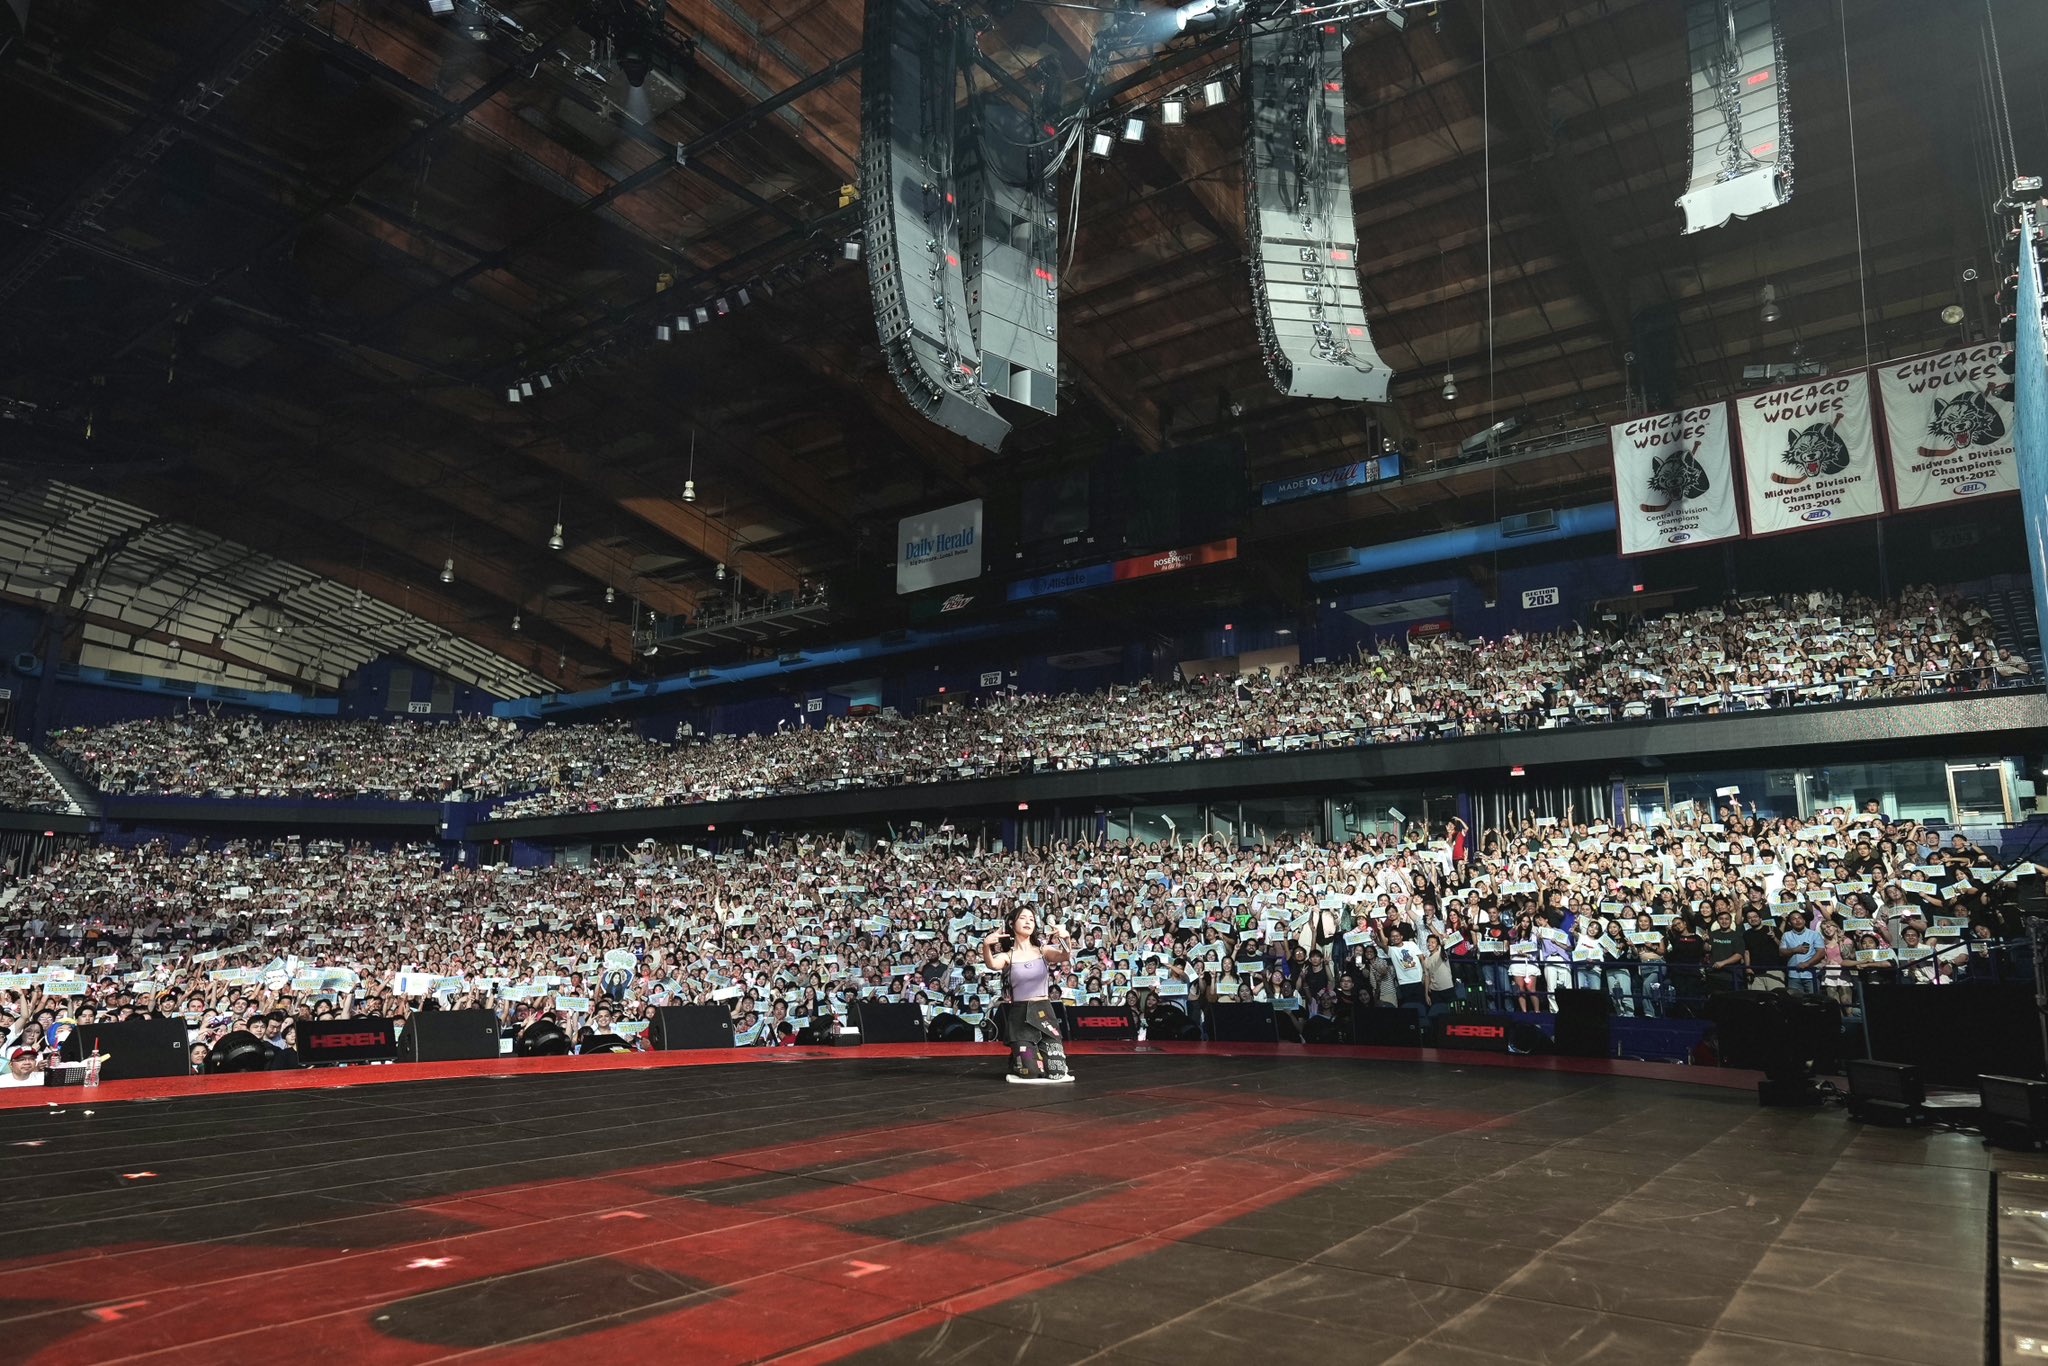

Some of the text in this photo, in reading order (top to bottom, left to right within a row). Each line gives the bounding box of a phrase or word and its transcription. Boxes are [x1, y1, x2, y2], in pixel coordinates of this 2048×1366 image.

[1897, 345, 2002, 380] CHICAGO
[1908, 363, 1997, 393] WOLVES
[1754, 379, 1850, 409] CHICAGO
[1763, 397, 1844, 423] WOLVES
[1625, 408, 1711, 436] CHICAGO
[1634, 424, 1705, 449] WOLVES
[1911, 455, 1964, 473] Midwest
[1931, 459, 2002, 477] Champions
[1278, 480, 1304, 493] MADE
[1306, 477, 1318, 486] TO
[1319, 463, 1360, 485] Chill
[1940, 469, 1997, 486] 2011-2012
[1764, 475, 1862, 499] Midwest Division
[1960, 484, 1981, 493] AHL
[1782, 488, 1846, 505] Champions
[1788, 497, 1842, 513] 2013-2014
[1646, 506, 1708, 522] Central Division
[1656, 514, 1700, 527] Champions
[1659, 523, 1699, 535] 2021-2022
[905, 526, 975, 561] Daily Herald
[1153, 553, 1193, 568] ROSEMONT
[1045, 572, 1086, 589] Allstate
[1525, 588, 1556, 598] SECTION
[1528, 594, 1553, 607] 203
[983, 676, 999, 686] 202
[809, 702, 821, 711] 201
[1077, 1016, 1129, 1028] HEREH
[1446, 1025, 1505, 1038] HEREH
[310, 1032, 386, 1049] HEREH
